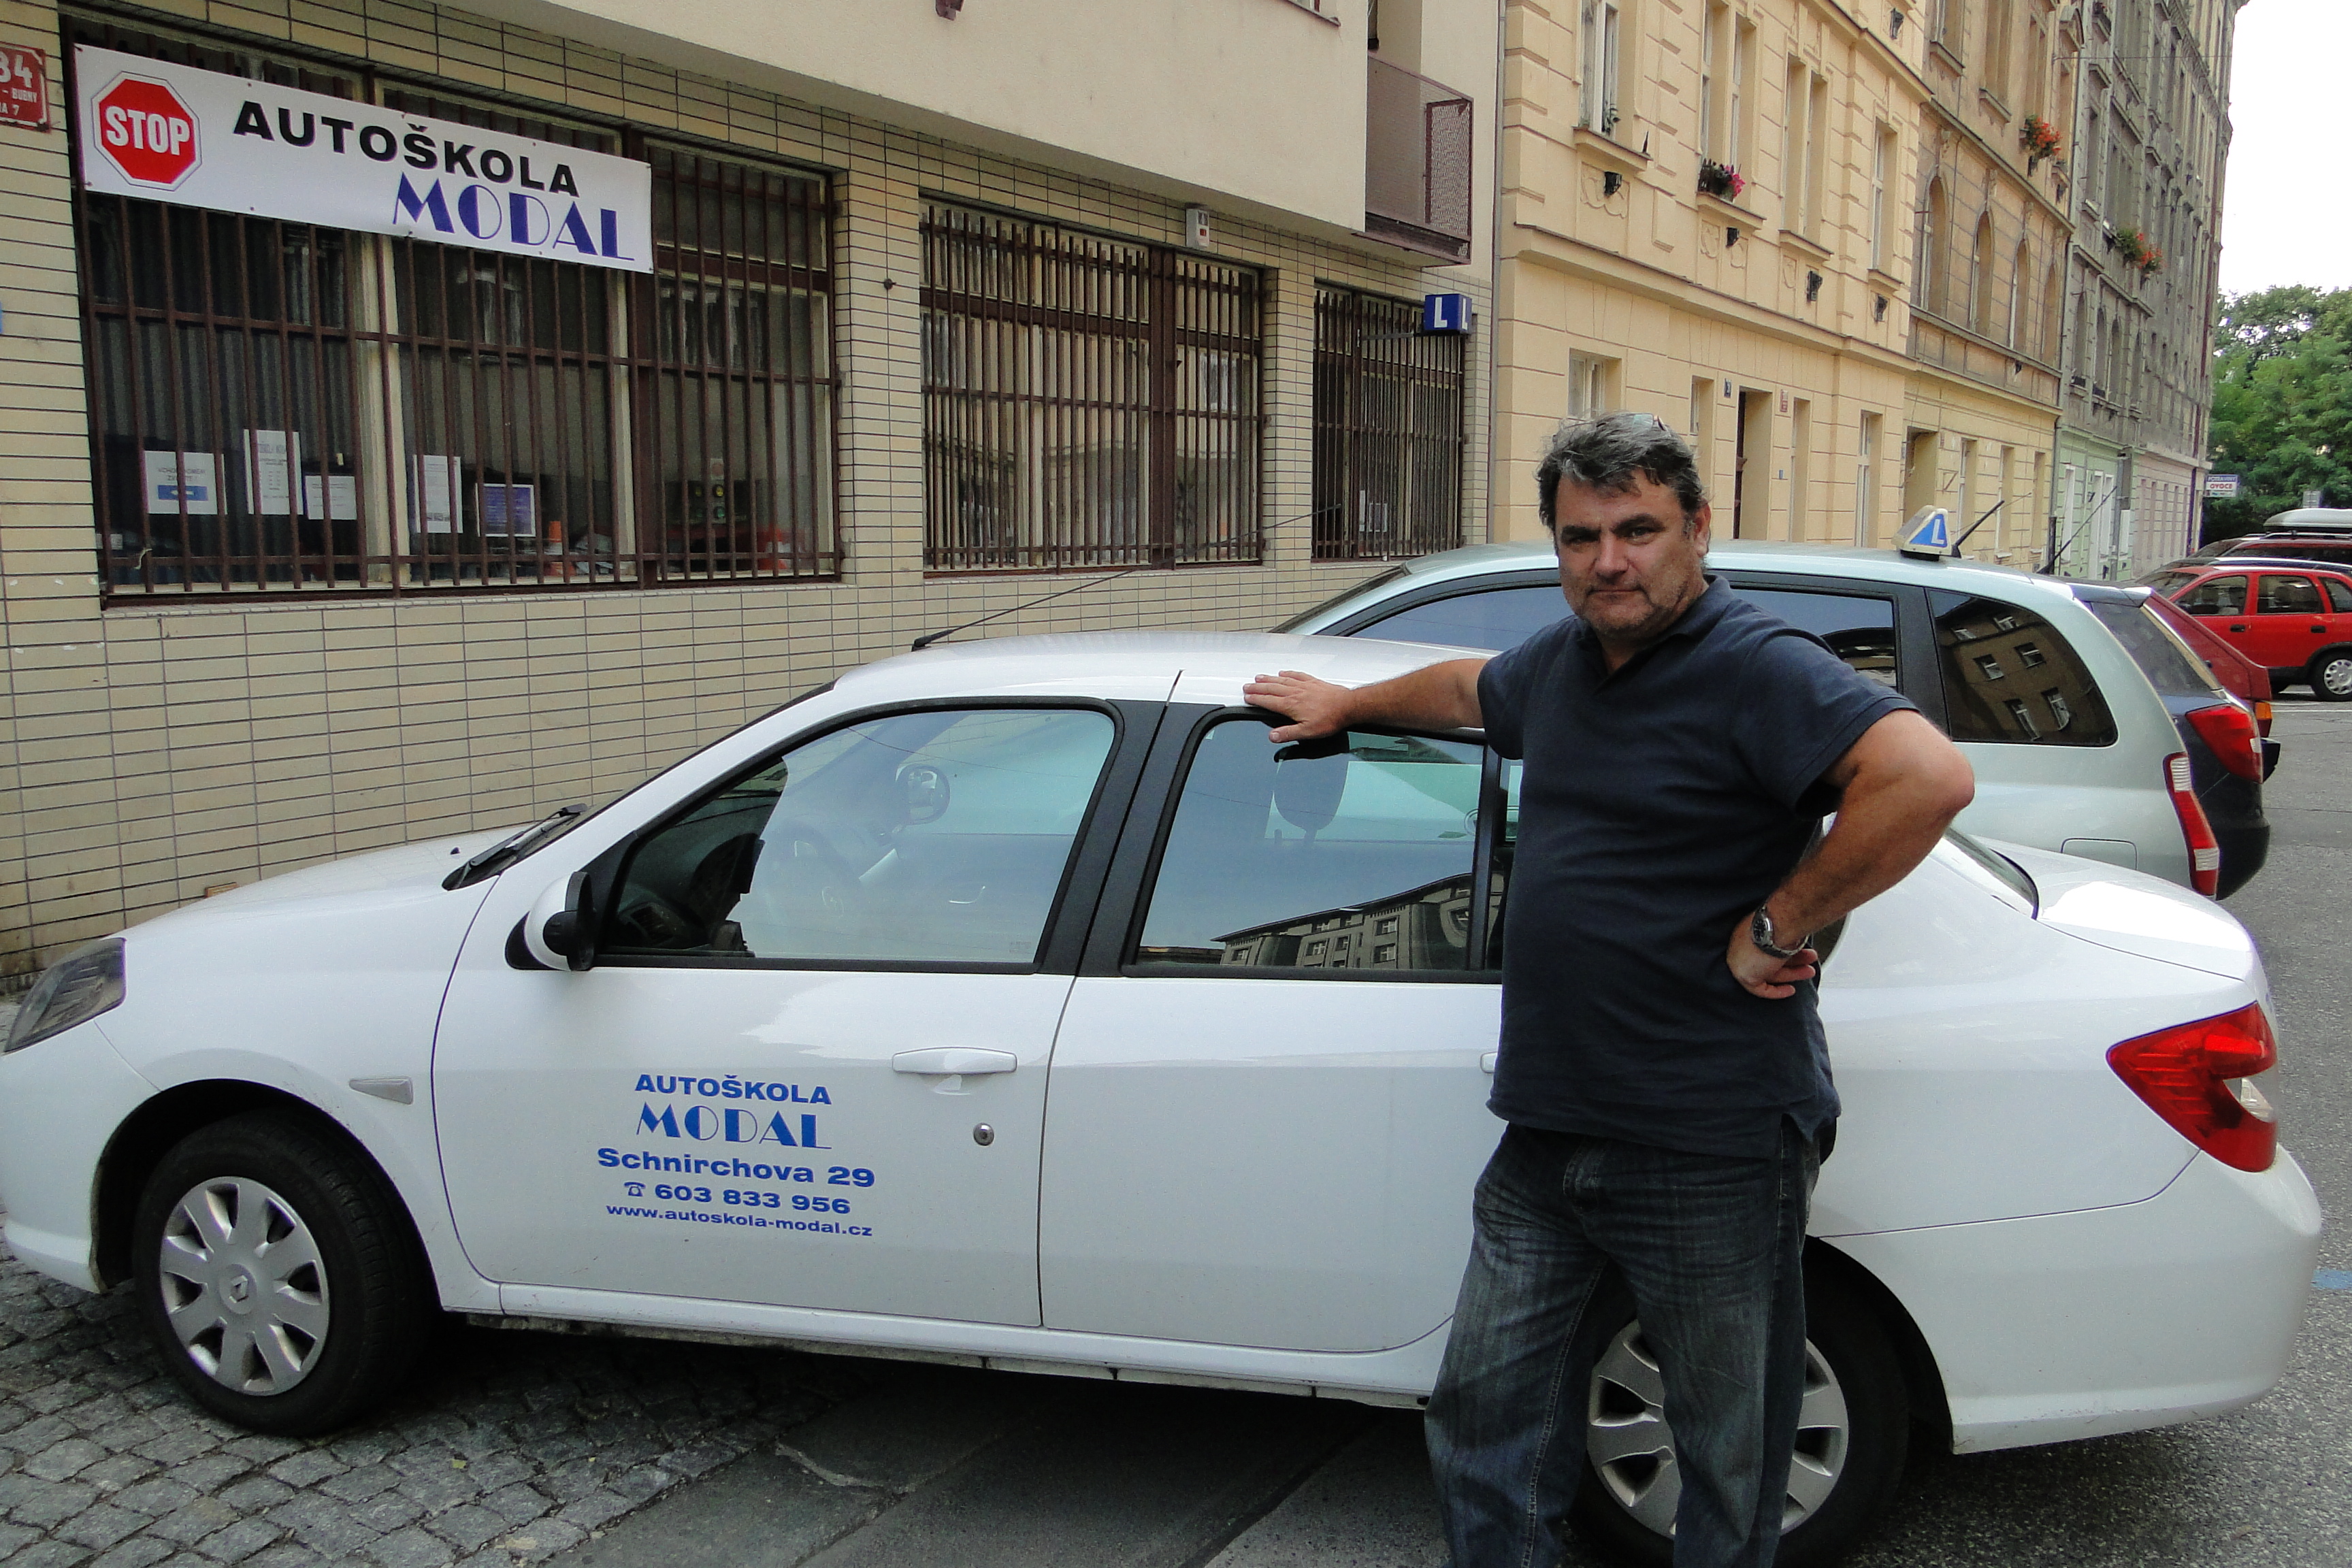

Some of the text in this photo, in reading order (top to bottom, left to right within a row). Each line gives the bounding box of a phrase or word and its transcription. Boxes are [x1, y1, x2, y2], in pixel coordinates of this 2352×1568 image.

[12, 87, 37, 103] BUBNY
[12, 103, 20, 116] 7
[105, 105, 190, 156] STOP
[233, 101, 579, 197] AUTOŠKOLA
[393, 172, 635, 261] MODAL
[1434, 297, 1448, 328] L
[1461, 298, 1468, 331] L
[1931, 519, 1945, 544] L
[635, 1074, 832, 1105] AUTOŠKOLA
[636, 1102, 832, 1149] MODAL
[597, 1147, 875, 1188] Schnirchova 29
[654, 1183, 851, 1215] 603 833 956
[606, 1205, 872, 1237] www.autoskola-modal.cz
